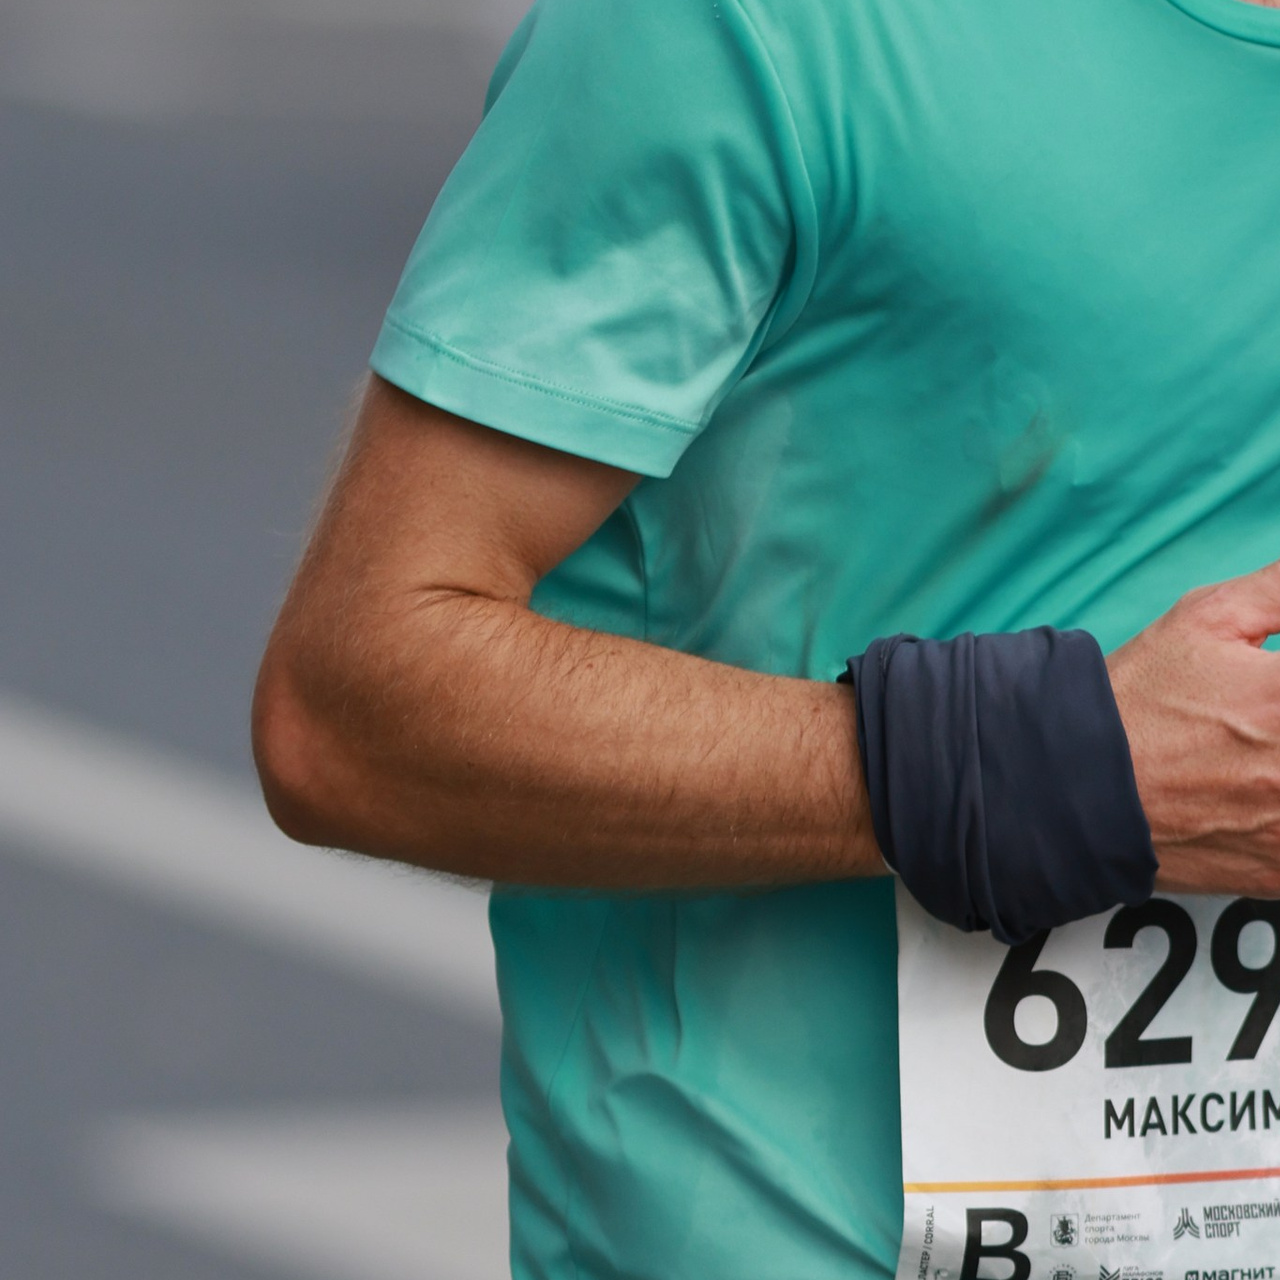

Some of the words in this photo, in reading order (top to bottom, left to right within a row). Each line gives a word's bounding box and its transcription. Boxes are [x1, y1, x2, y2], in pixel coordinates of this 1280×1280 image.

[924, 1205, 934, 1245] CORRAL
[1084, 1213, 1141, 1223] Департамент
[1084, 1225, 1115, 1234] спорта
[1204, 1221, 1241, 1239] СПОРТ
